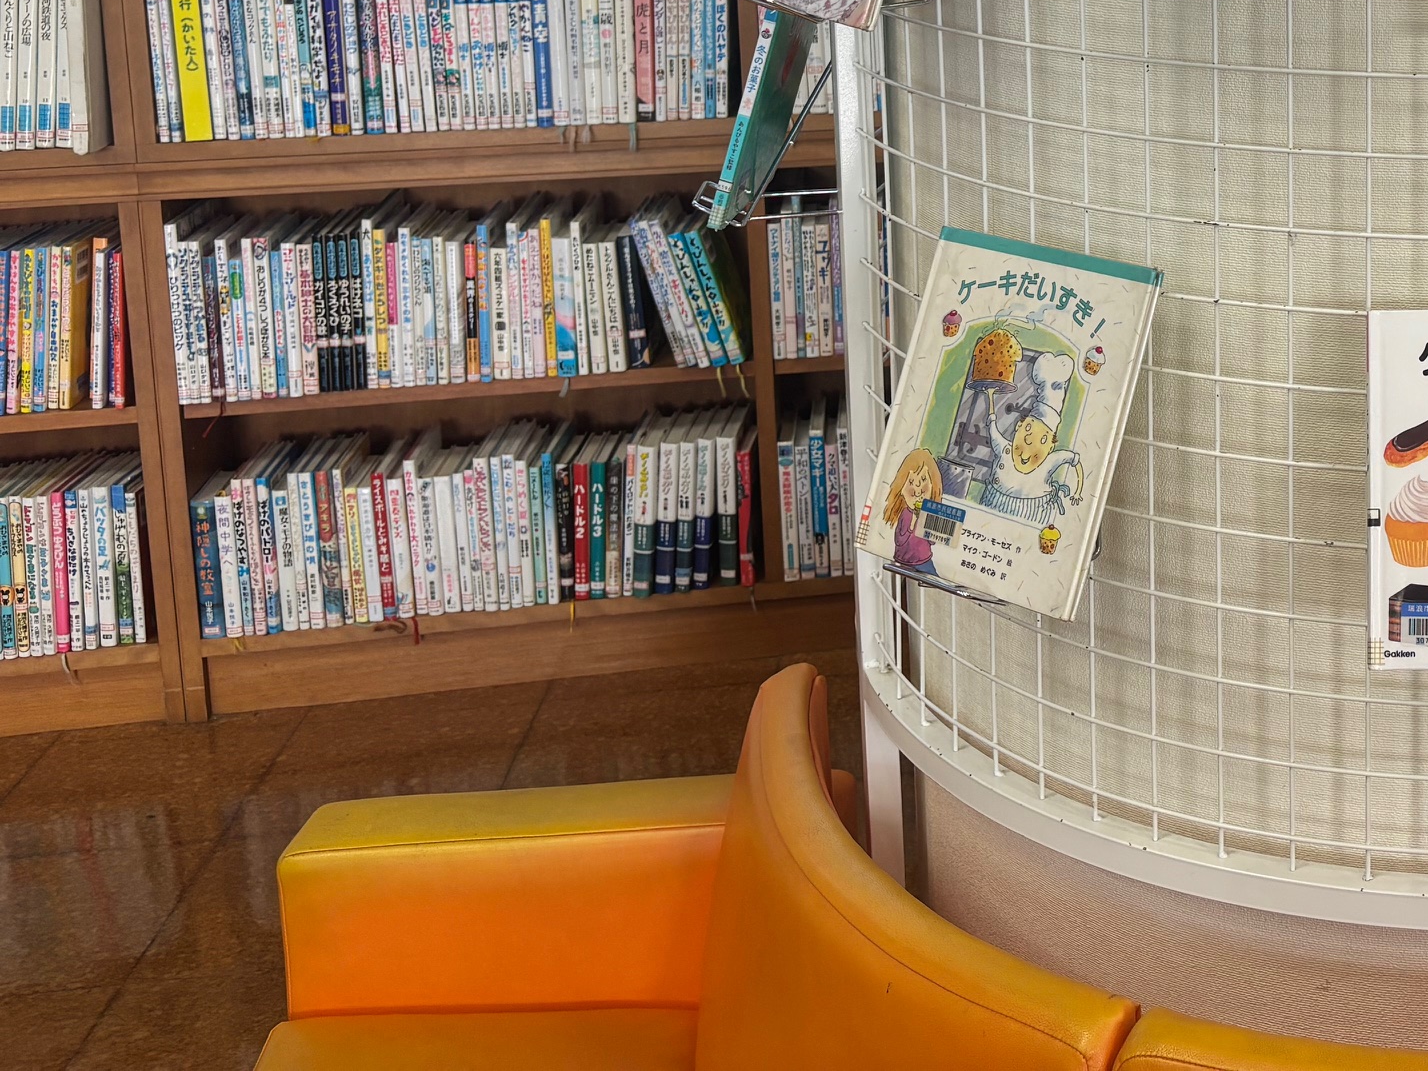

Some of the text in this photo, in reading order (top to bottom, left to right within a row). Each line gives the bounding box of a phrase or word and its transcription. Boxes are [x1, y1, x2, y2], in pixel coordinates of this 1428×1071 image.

[636, 3, 649, 55] 虎と月
[716, 5, 727, 62] ぼくのハヤテ
[745, 43, 768, 94] 冬のお菓子
[815, 240, 832, 284] ユウキ
[592, 483, 603, 537] ハードル3
[828, 452, 839, 515] クマ追い犬タロ
[231, 489, 249, 578] おばけのなつやすみ
[300, 480, 317, 565] さとうきび畑の唄
[373, 479, 390, 572] ライスボールとみそ蔵と
[574, 484, 586, 539] ハードル2
[196, 521, 215, 596] 神隠しの教室
[960, 559, 977, 570] あさの
[980, 566, 996, 577] めぐみ
[962, 544, 1003, 563] マイク・ゴードン
[1383, 649, 1416, 658] Gakken
